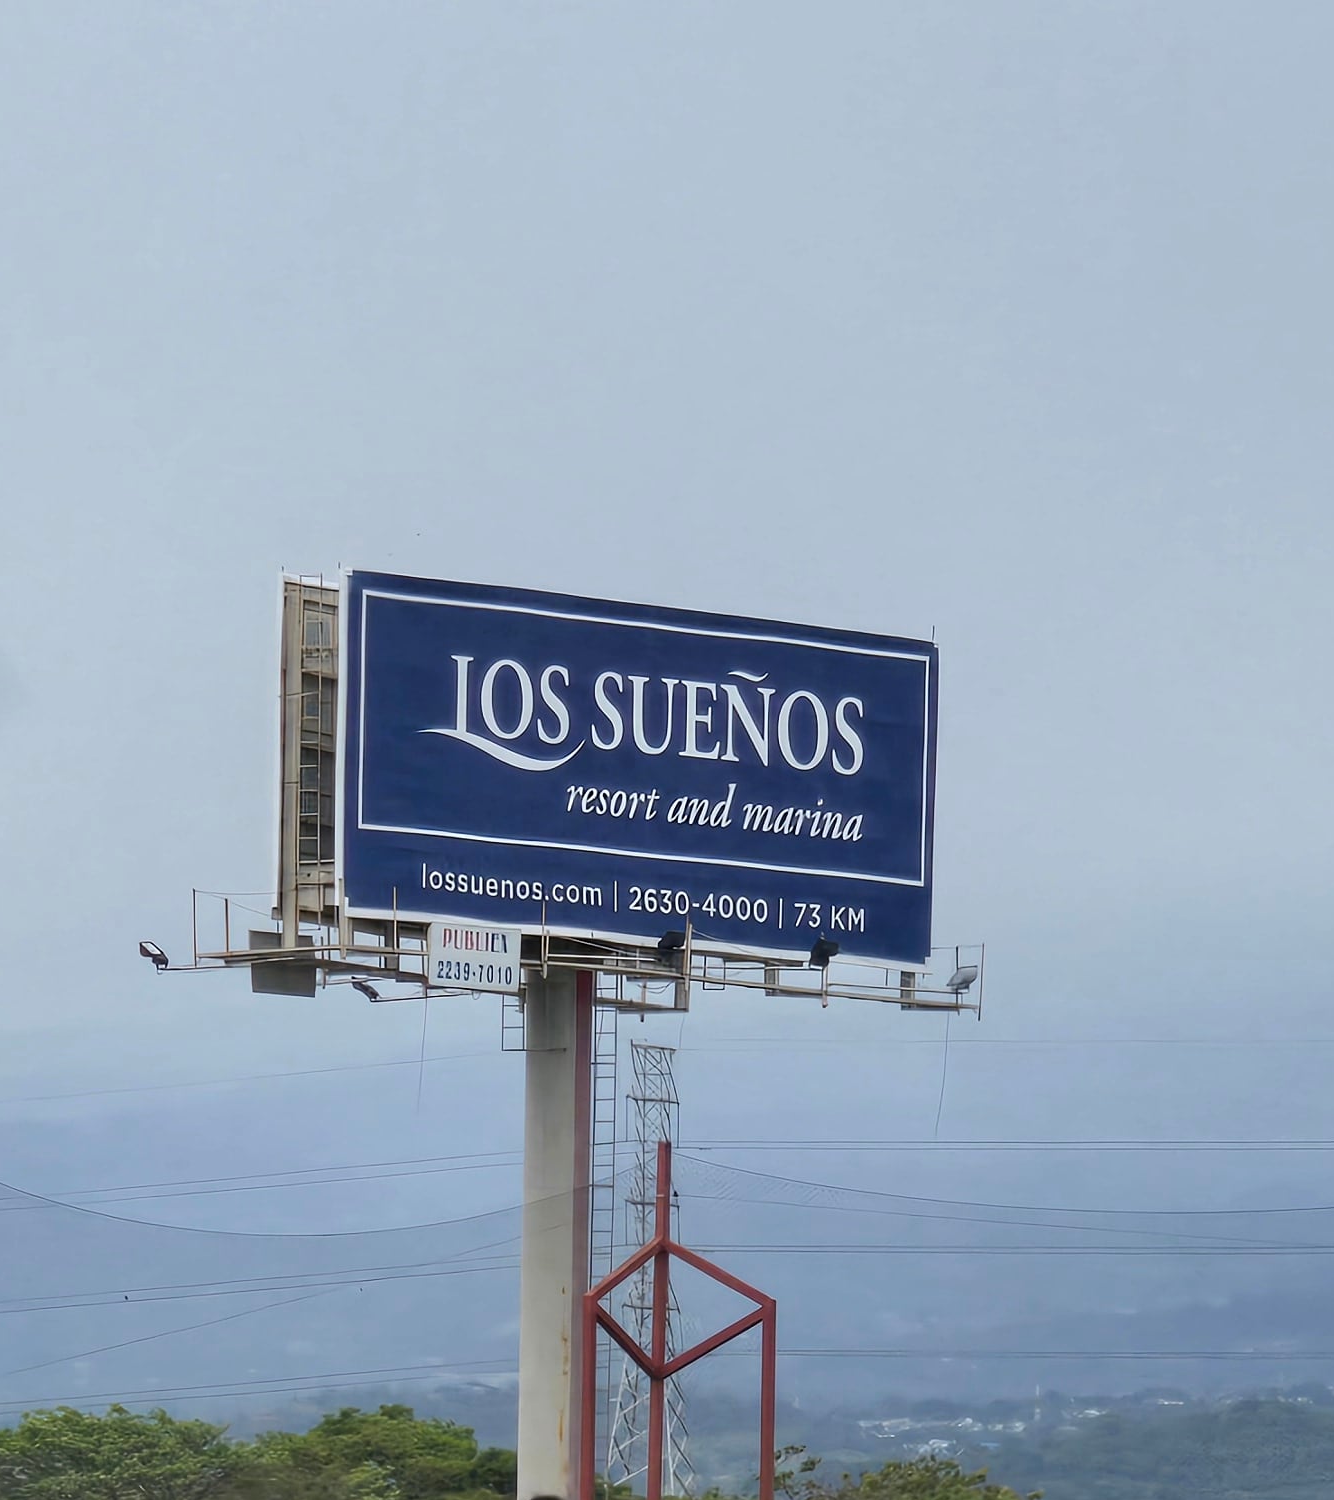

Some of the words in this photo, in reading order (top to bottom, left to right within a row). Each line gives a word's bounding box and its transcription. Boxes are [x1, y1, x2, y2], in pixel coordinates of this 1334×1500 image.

[418, 655, 585, 771] LOS
[591, 670, 864, 776] SUEÑOS
[566, 784, 660, 822] resort
[667, 783, 736, 828] and
[742, 798, 863, 842] marina
[422, 862, 603, 907] lossuenos.com
[628, 886, 768, 924] 2630-4000
[794, 902, 821, 929] 73
[831, 905, 865, 933] KM
